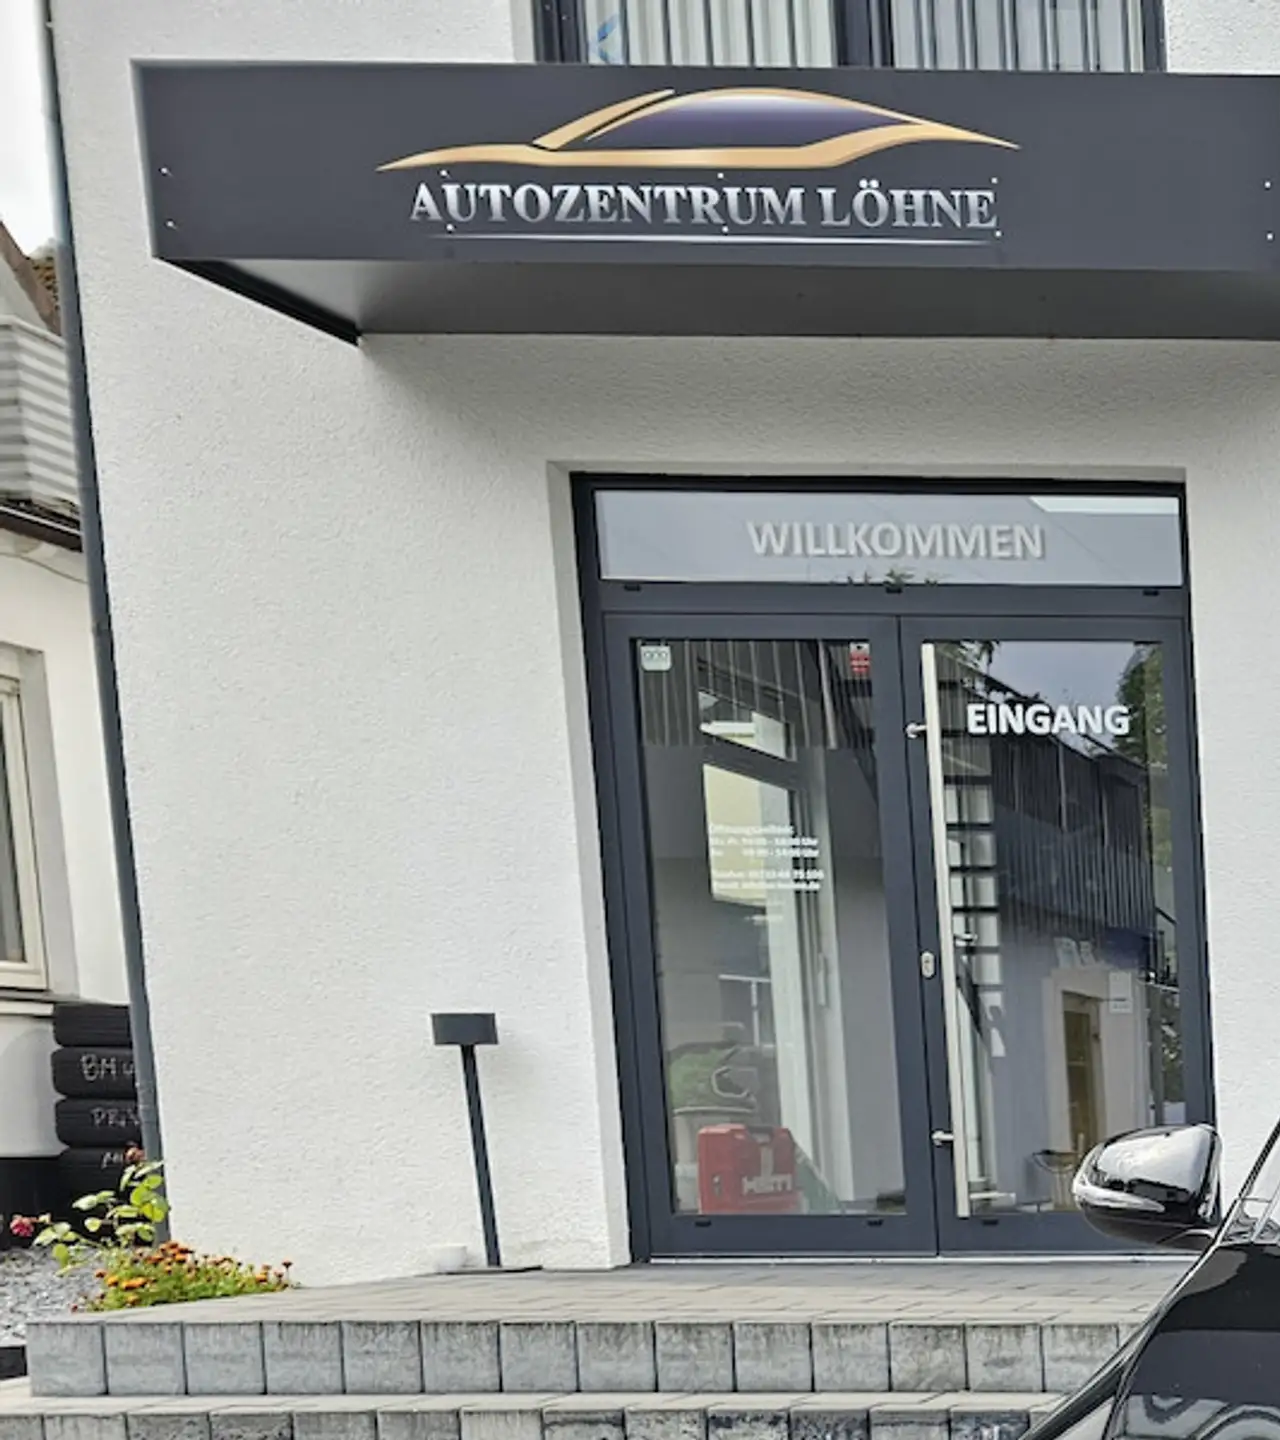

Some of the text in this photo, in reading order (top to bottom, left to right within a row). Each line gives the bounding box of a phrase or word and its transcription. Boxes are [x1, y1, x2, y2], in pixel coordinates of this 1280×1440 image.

[410, 179, 998, 229] AUTOZENTRUM LÖHNE
[747, 521, 1047, 559] WILLKOMMEN
[966, 702, 1130, 736] EINGANG
